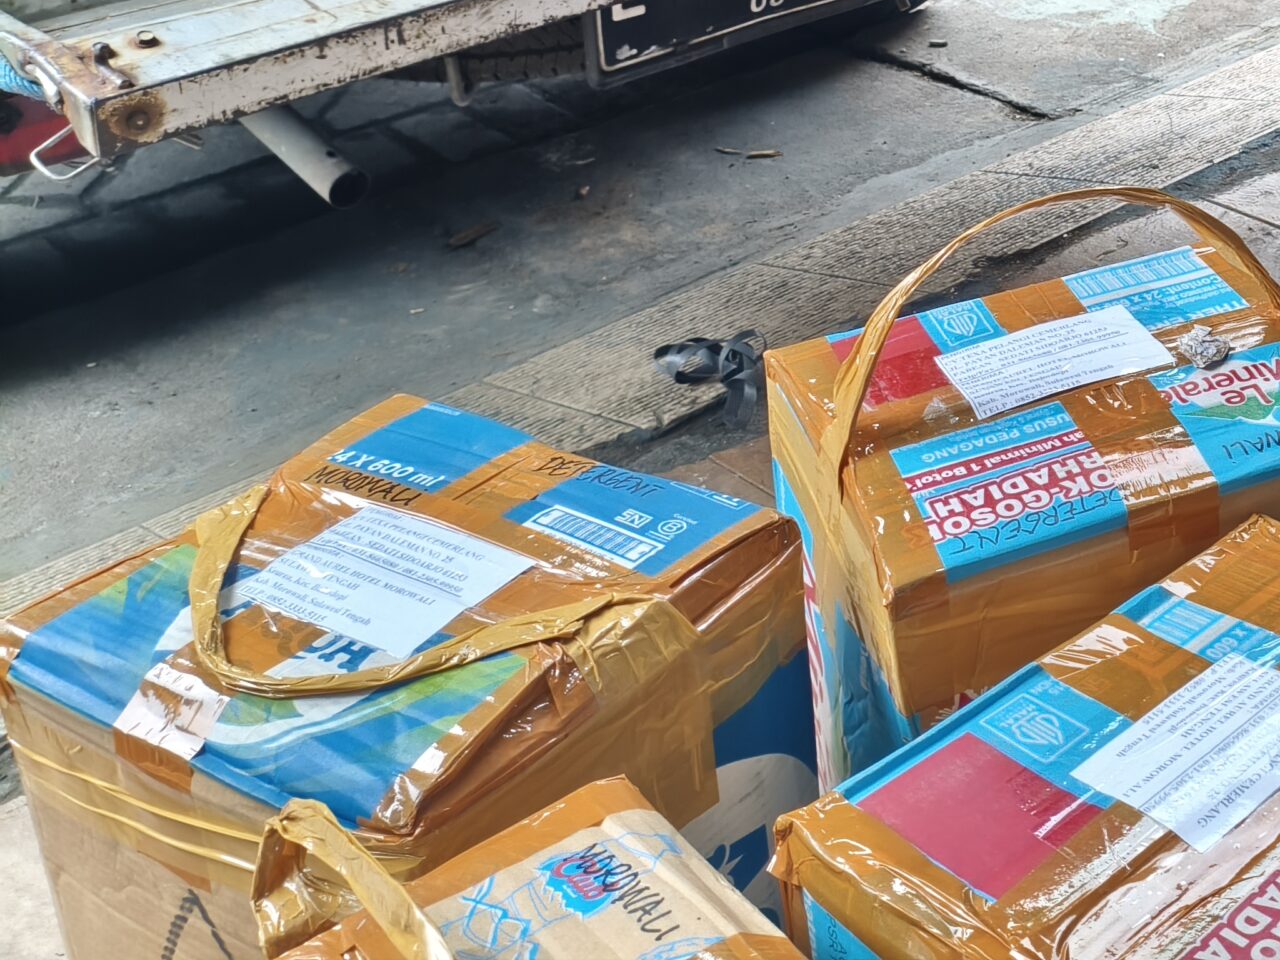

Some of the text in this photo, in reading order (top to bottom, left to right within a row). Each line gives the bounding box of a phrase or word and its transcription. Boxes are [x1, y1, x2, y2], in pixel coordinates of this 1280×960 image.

[1144, 290, 1160, 301] 24
[1161, 274, 1220, 296] Content:
[962, 351, 998, 366] PAYAN
[1220, 379, 1273, 415] Le
[919, 427, 1020, 464] PEDAGANG
[982, 437, 1059, 468] Minimal
[367, 456, 411, 480] 600
[408, 467, 445, 490] ml
[349, 523, 386, 538] PAYAN
[421, 536, 489, 562] CEMERLANG
[393, 551, 448, 574] SIDOARJO
[439, 568, 470, 582] 61253
[319, 573, 363, 591] TENGAH
[347, 570, 384, 586] HOTEL
[377, 582, 439, 606] MOROWALI
[336, 609, 377, 626] Tengah
[1113, 731, 1152, 759] Tengah
[1178, 724, 1217, 753] HOTEL
[1119, 751, 1183, 799] MOROWALI
[1190, 771, 1267, 828] CEMERLANG
[562, 840, 680, 941] MOROWALI
